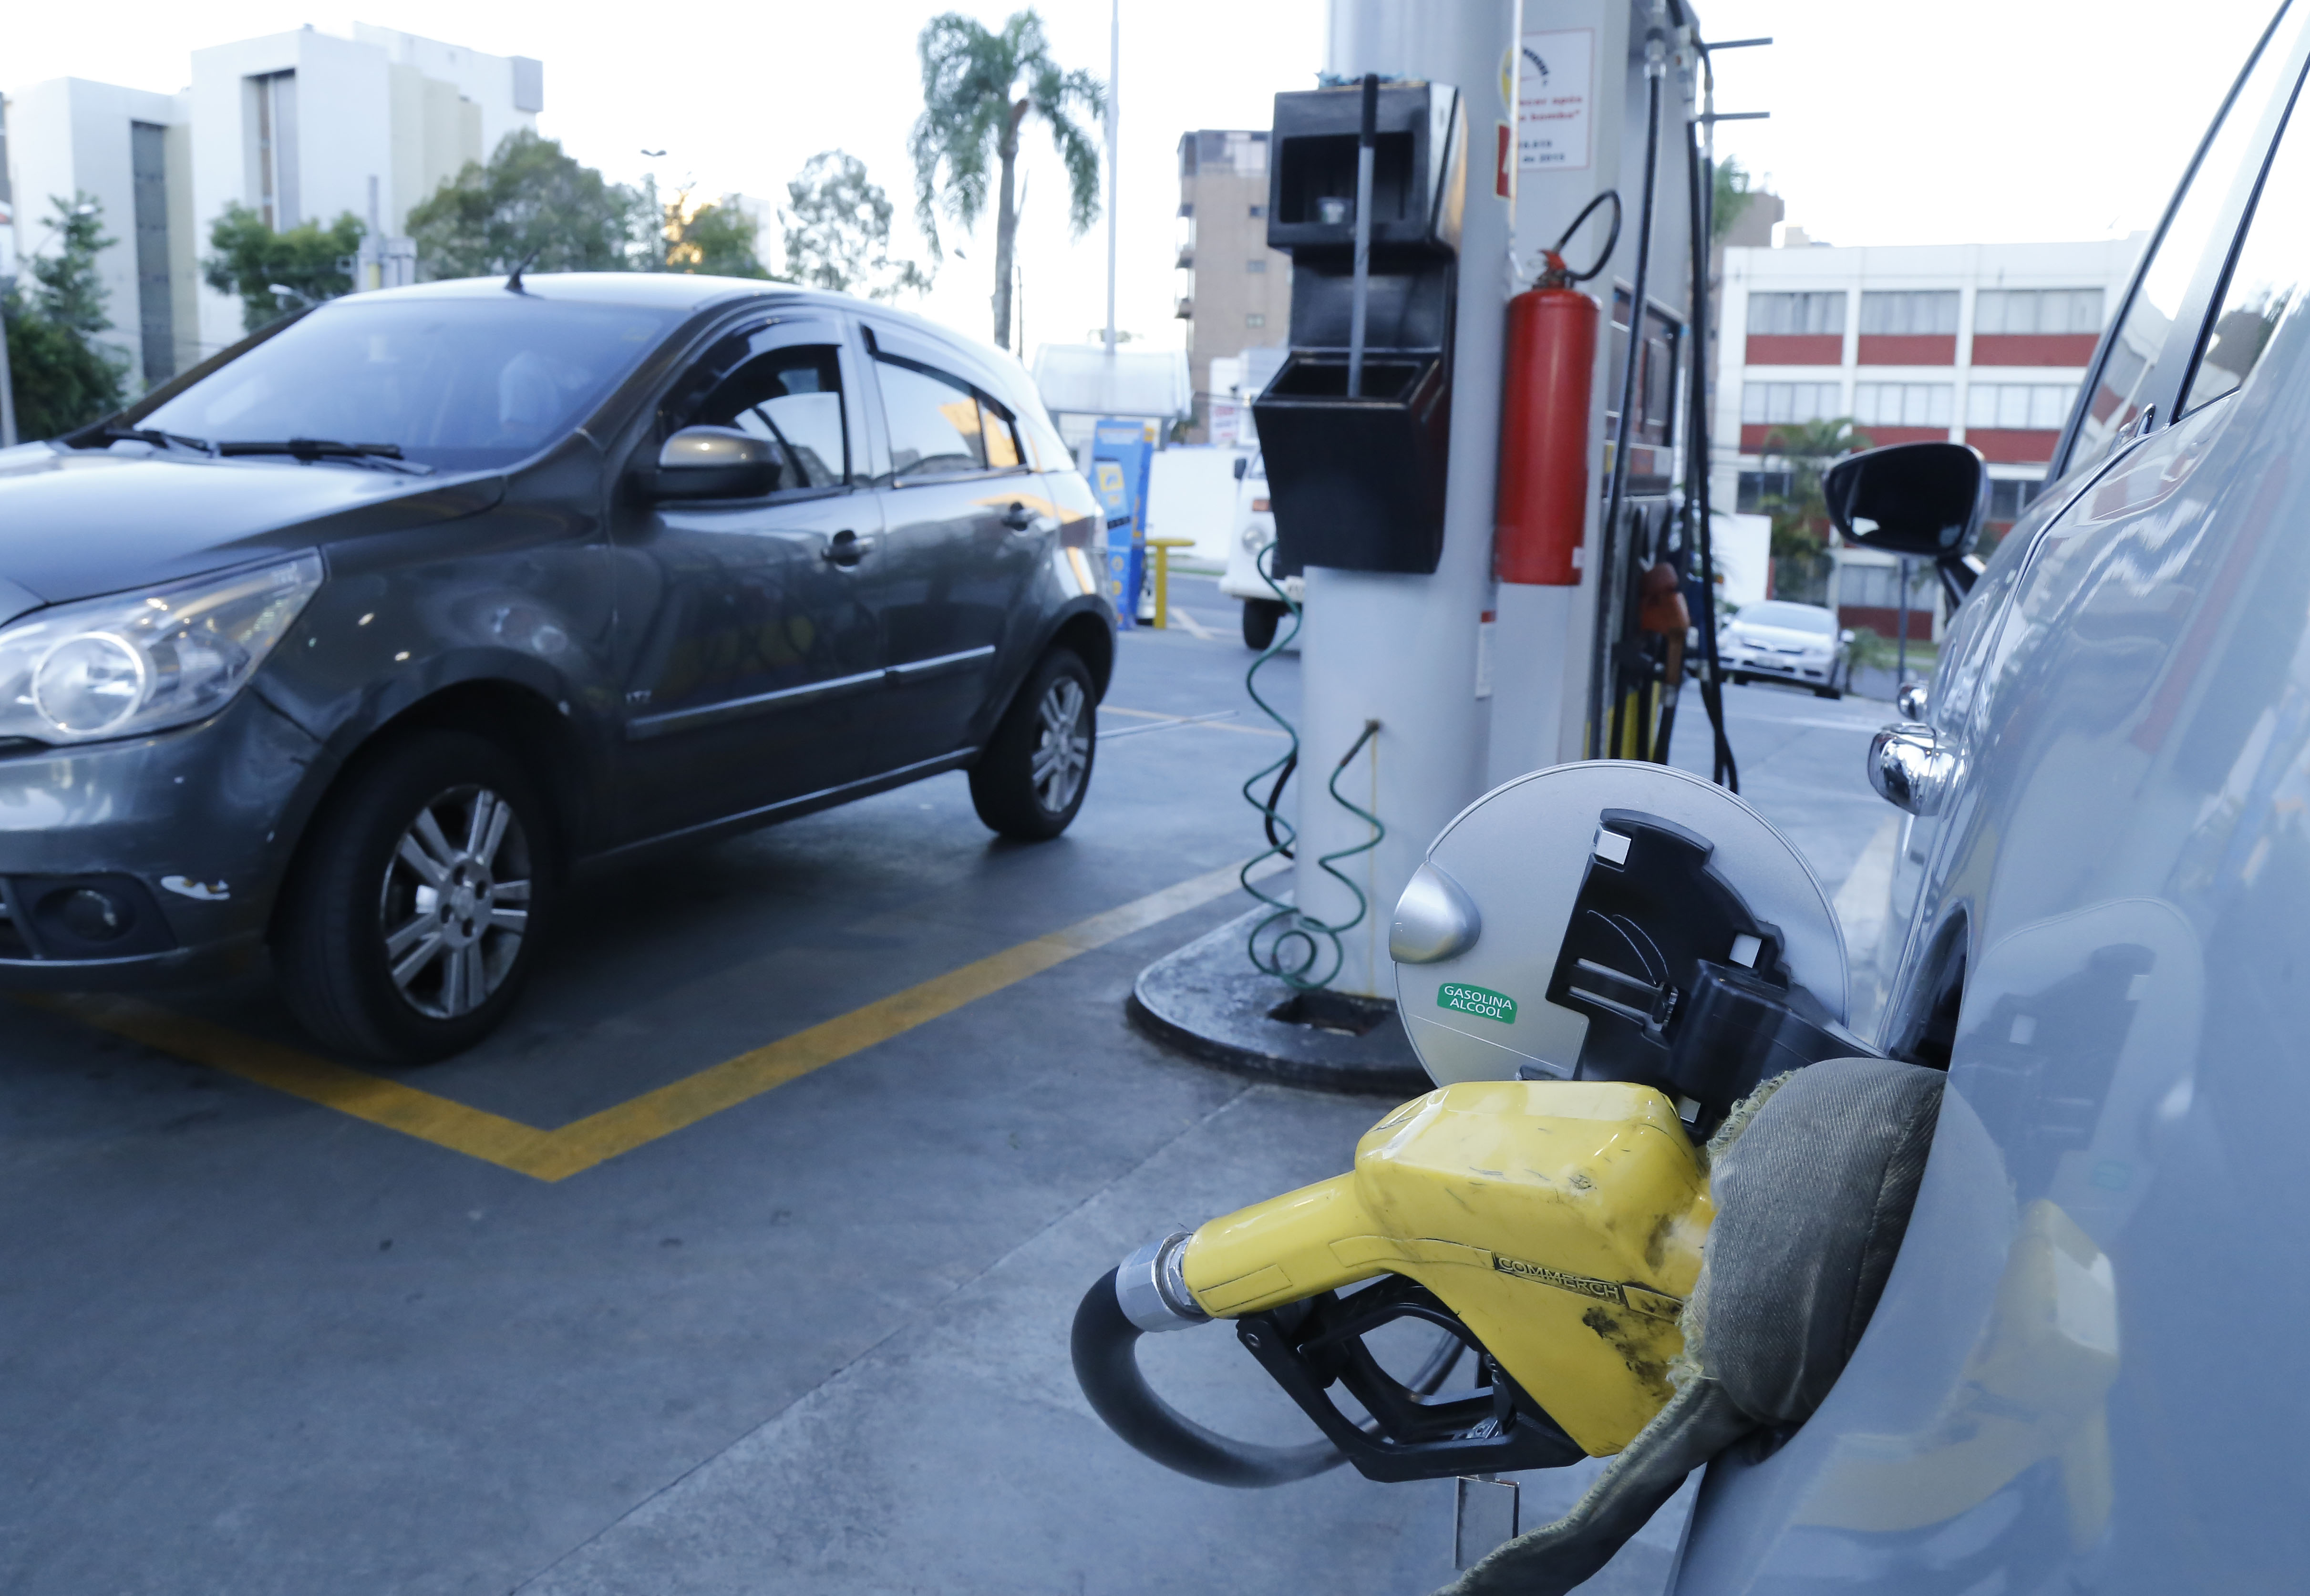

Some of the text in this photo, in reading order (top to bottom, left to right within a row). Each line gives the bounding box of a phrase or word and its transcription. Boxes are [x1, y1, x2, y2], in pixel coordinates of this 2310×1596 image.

[1444, 986, 1512, 1010] GASOLINA
[1450, 998, 1503, 1019] ALCOOL
[1498, 1257, 1620, 1300] COMMERCH
